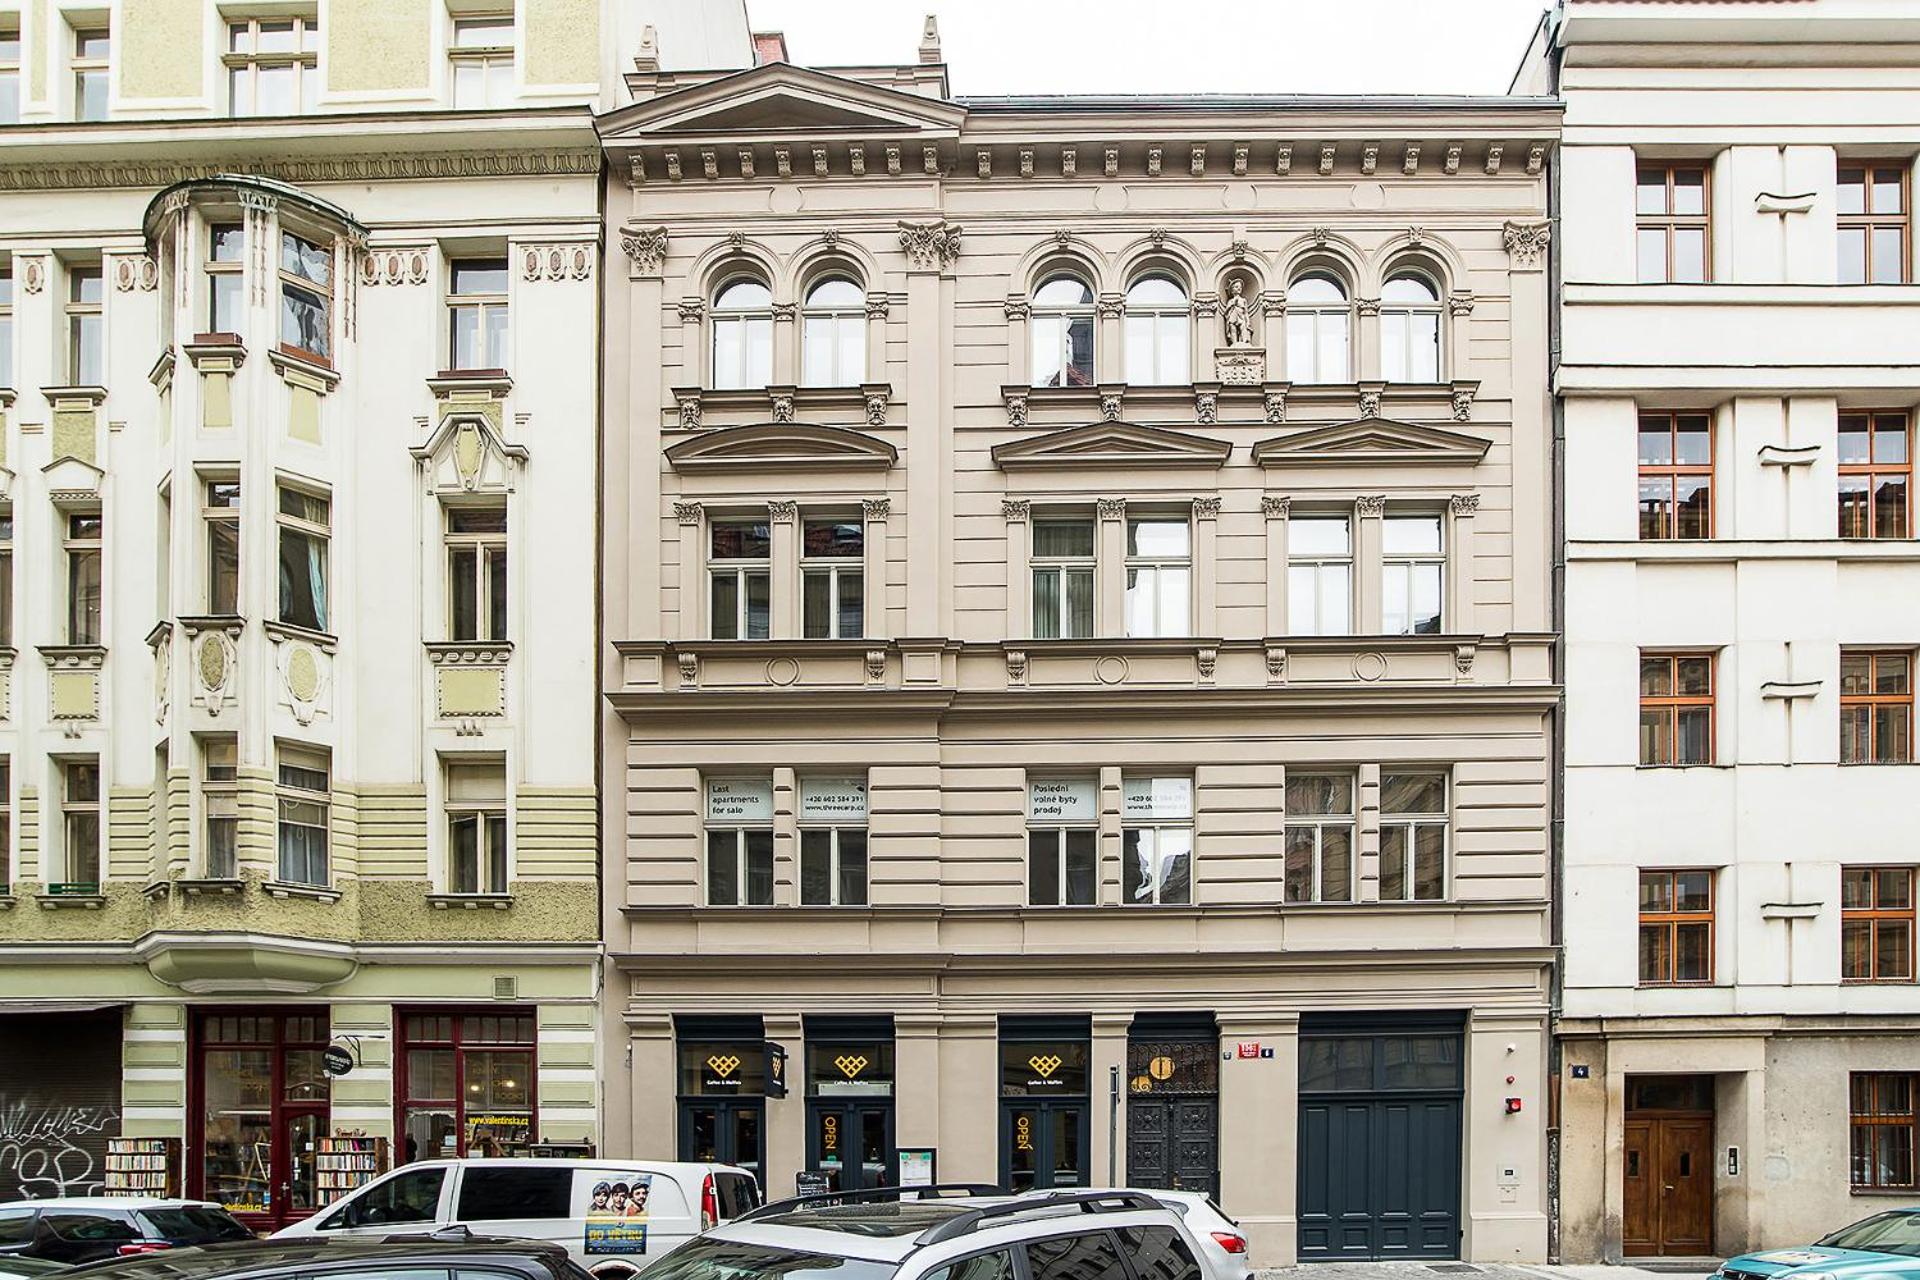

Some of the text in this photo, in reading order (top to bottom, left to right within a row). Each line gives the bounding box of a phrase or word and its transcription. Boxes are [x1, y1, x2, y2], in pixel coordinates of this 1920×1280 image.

[712, 785, 730, 793] Last
[712, 796, 760, 804] apartments
[1033, 795, 1078, 804] volné byty
[1033, 806, 1062, 815] prodej
[468, 1116, 529, 1126] www.valentinska.cz
[824, 1116, 837, 1149] OPEN
[1017, 1117, 1029, 1150] OPEN
